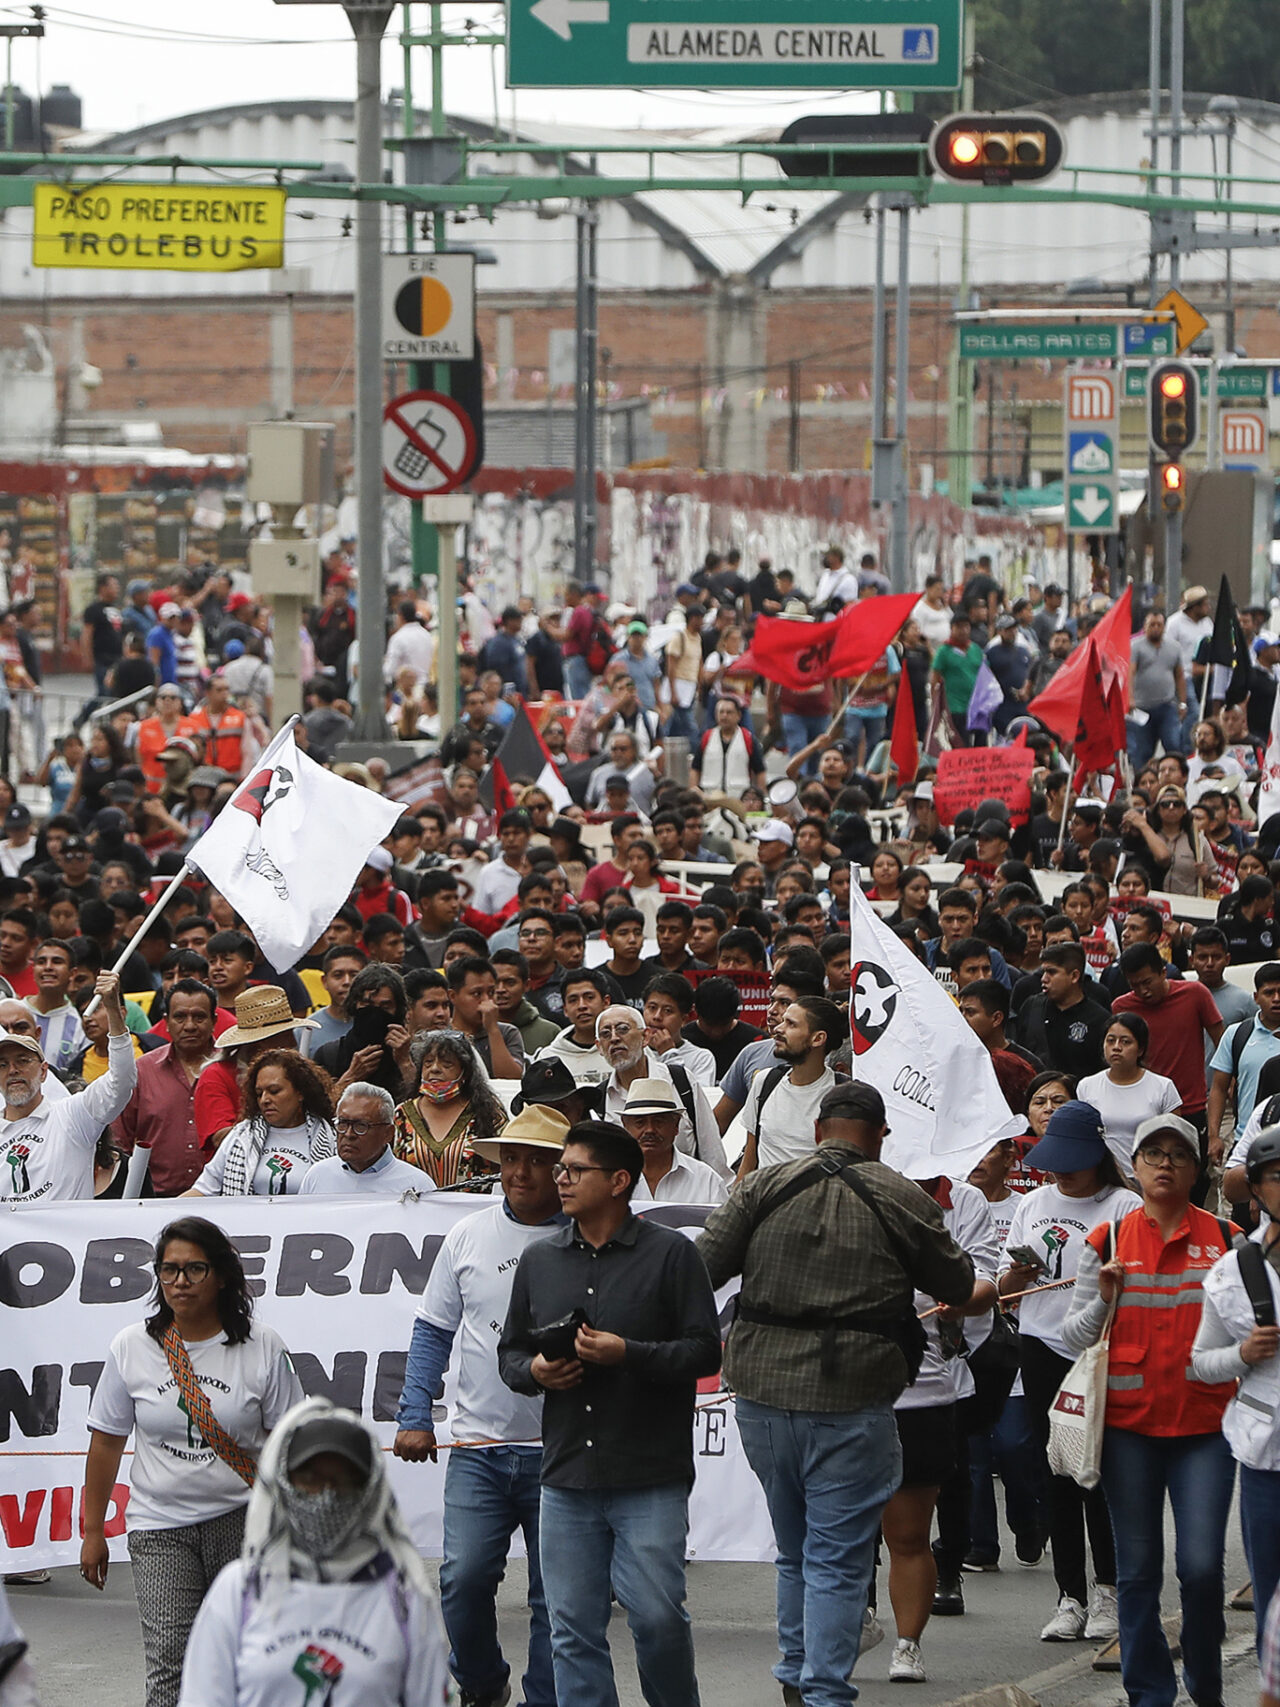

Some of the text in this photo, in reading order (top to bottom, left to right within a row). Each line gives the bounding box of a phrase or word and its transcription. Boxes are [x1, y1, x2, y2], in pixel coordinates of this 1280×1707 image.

[646, 30, 885, 57] ALAMEDA CENTRAL
[51, 197, 267, 223] PASO PREFERENTE
[60, 232, 258, 258] TROLEBUS
[409, 258, 437, 272] EJE
[384, 340, 460, 354] CENTRAL
[964, 334, 1041, 350] BELLAS
[1046, 334, 1112, 349] ARTES
[1032, 1218, 1049, 1230] ALTO
[497, 1257, 519, 1273] ALTO
[157, 1379, 177, 1396] ALTO
